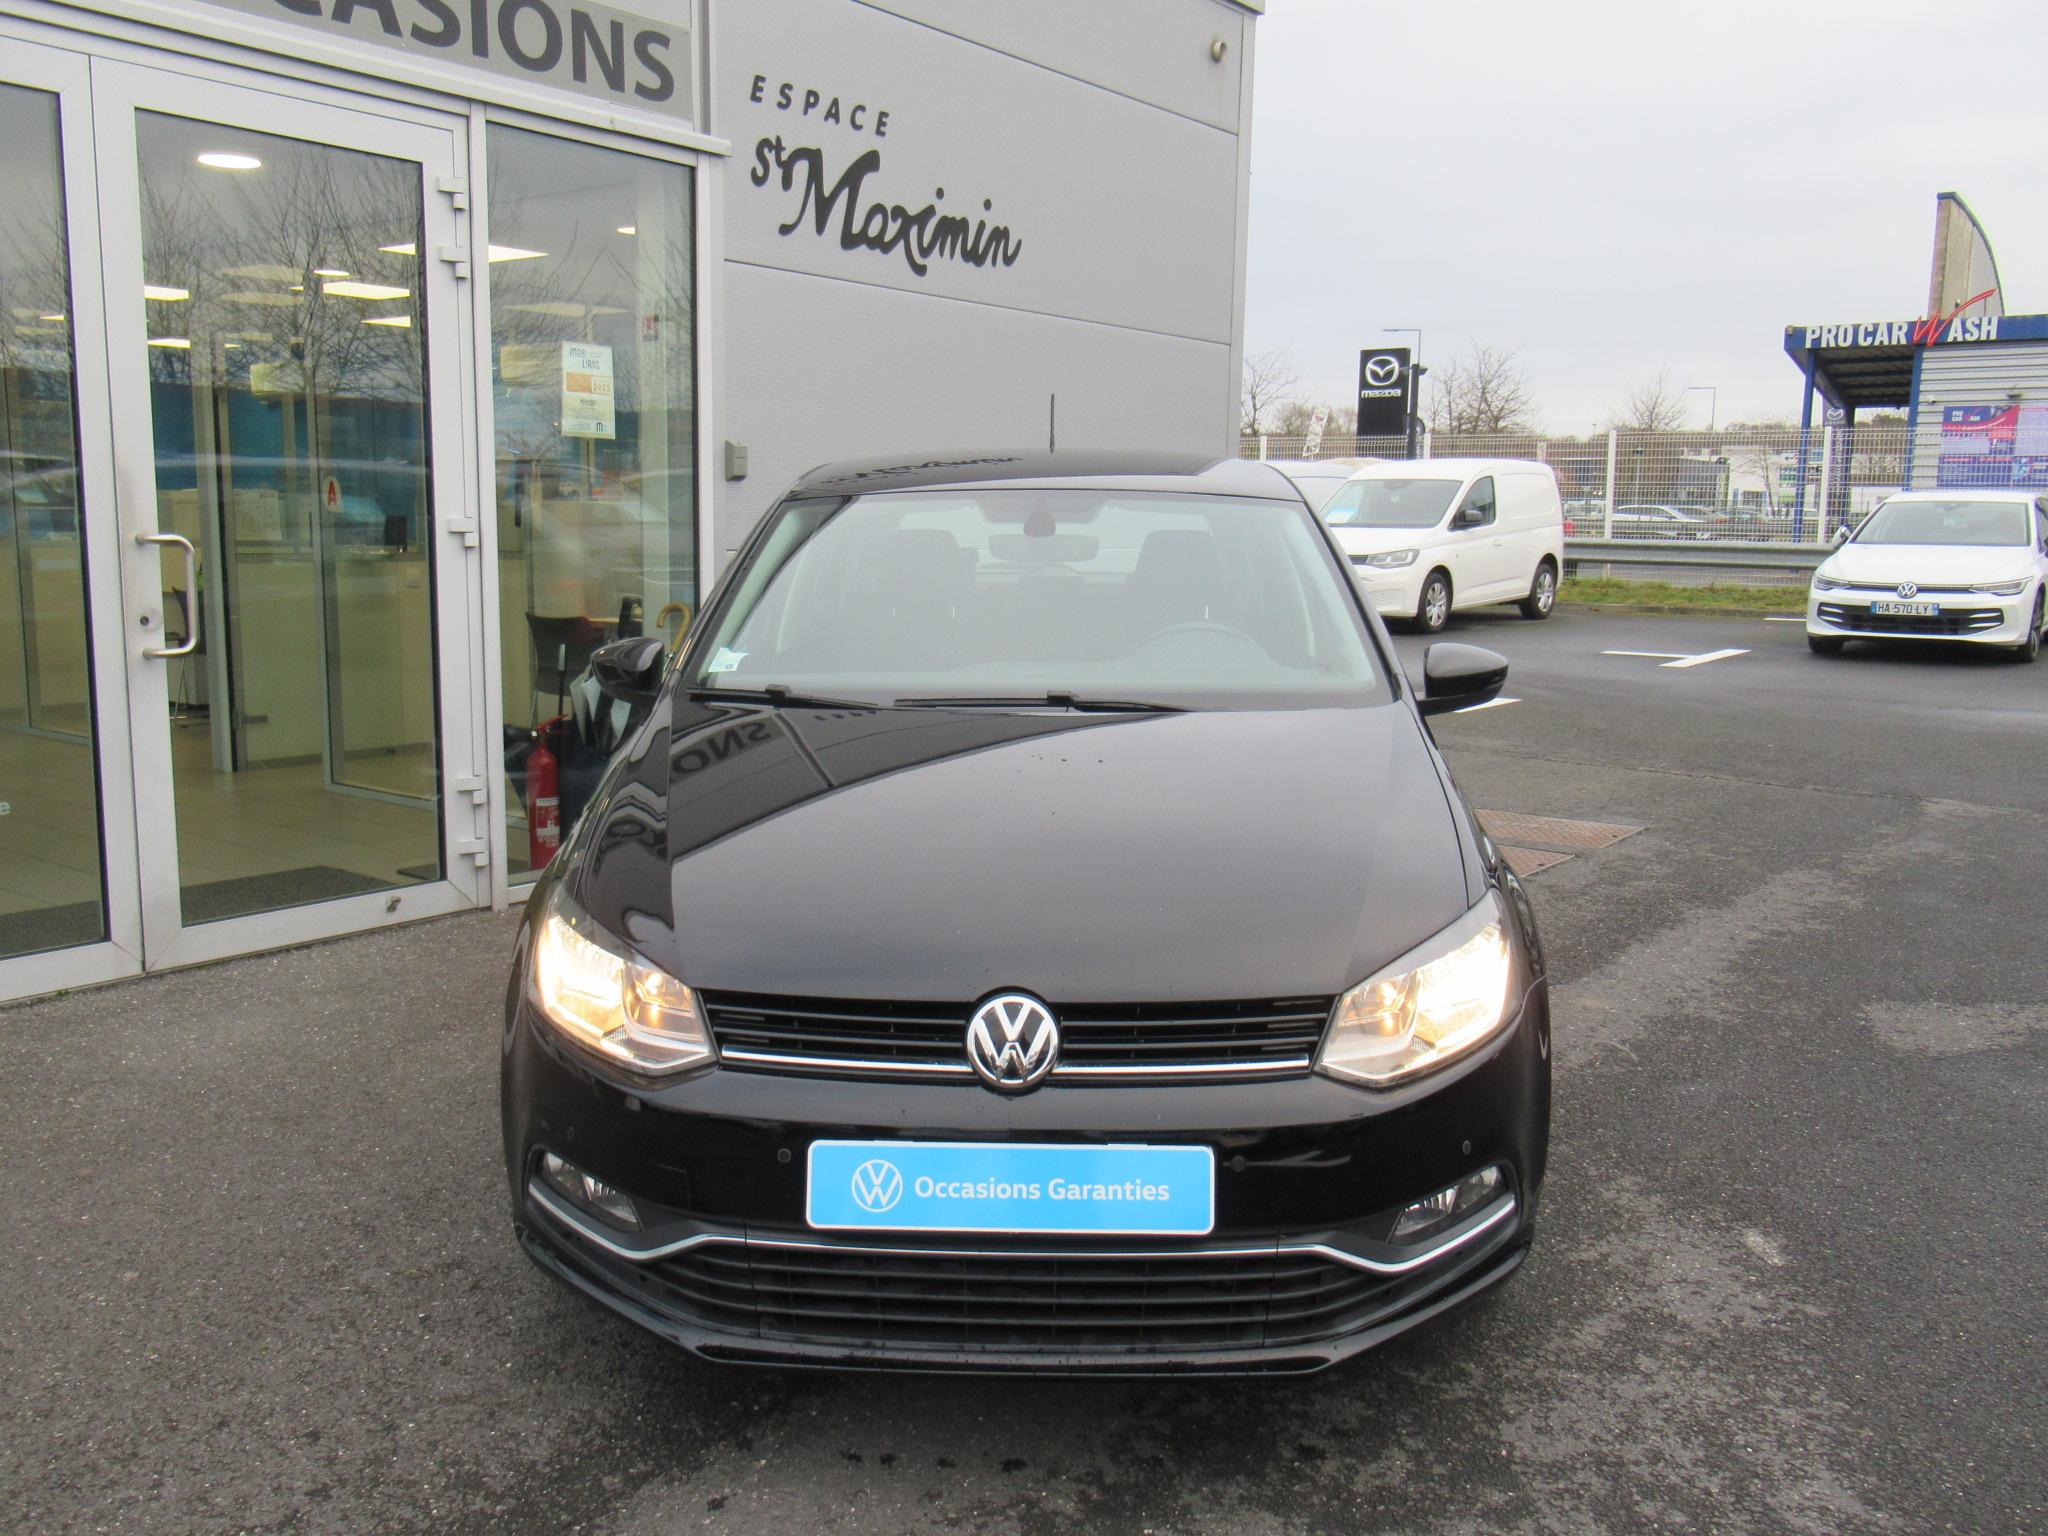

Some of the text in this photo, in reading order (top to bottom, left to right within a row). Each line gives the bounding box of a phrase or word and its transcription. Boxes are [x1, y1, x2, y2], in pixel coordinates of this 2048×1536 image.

[274, 0, 675, 102] SIONS
[750, 75, 890, 137] ESPACE
[778, 147, 1022, 277] Maximin
[1805, 288, 1999, 349] PRO CAR WASH
[1361, 389, 1401, 398] mazda
[327, 480, 337, 505] A
[914, 1176, 1041, 1200] Occasions
[1048, 1178, 1170, 1201] Garanties
